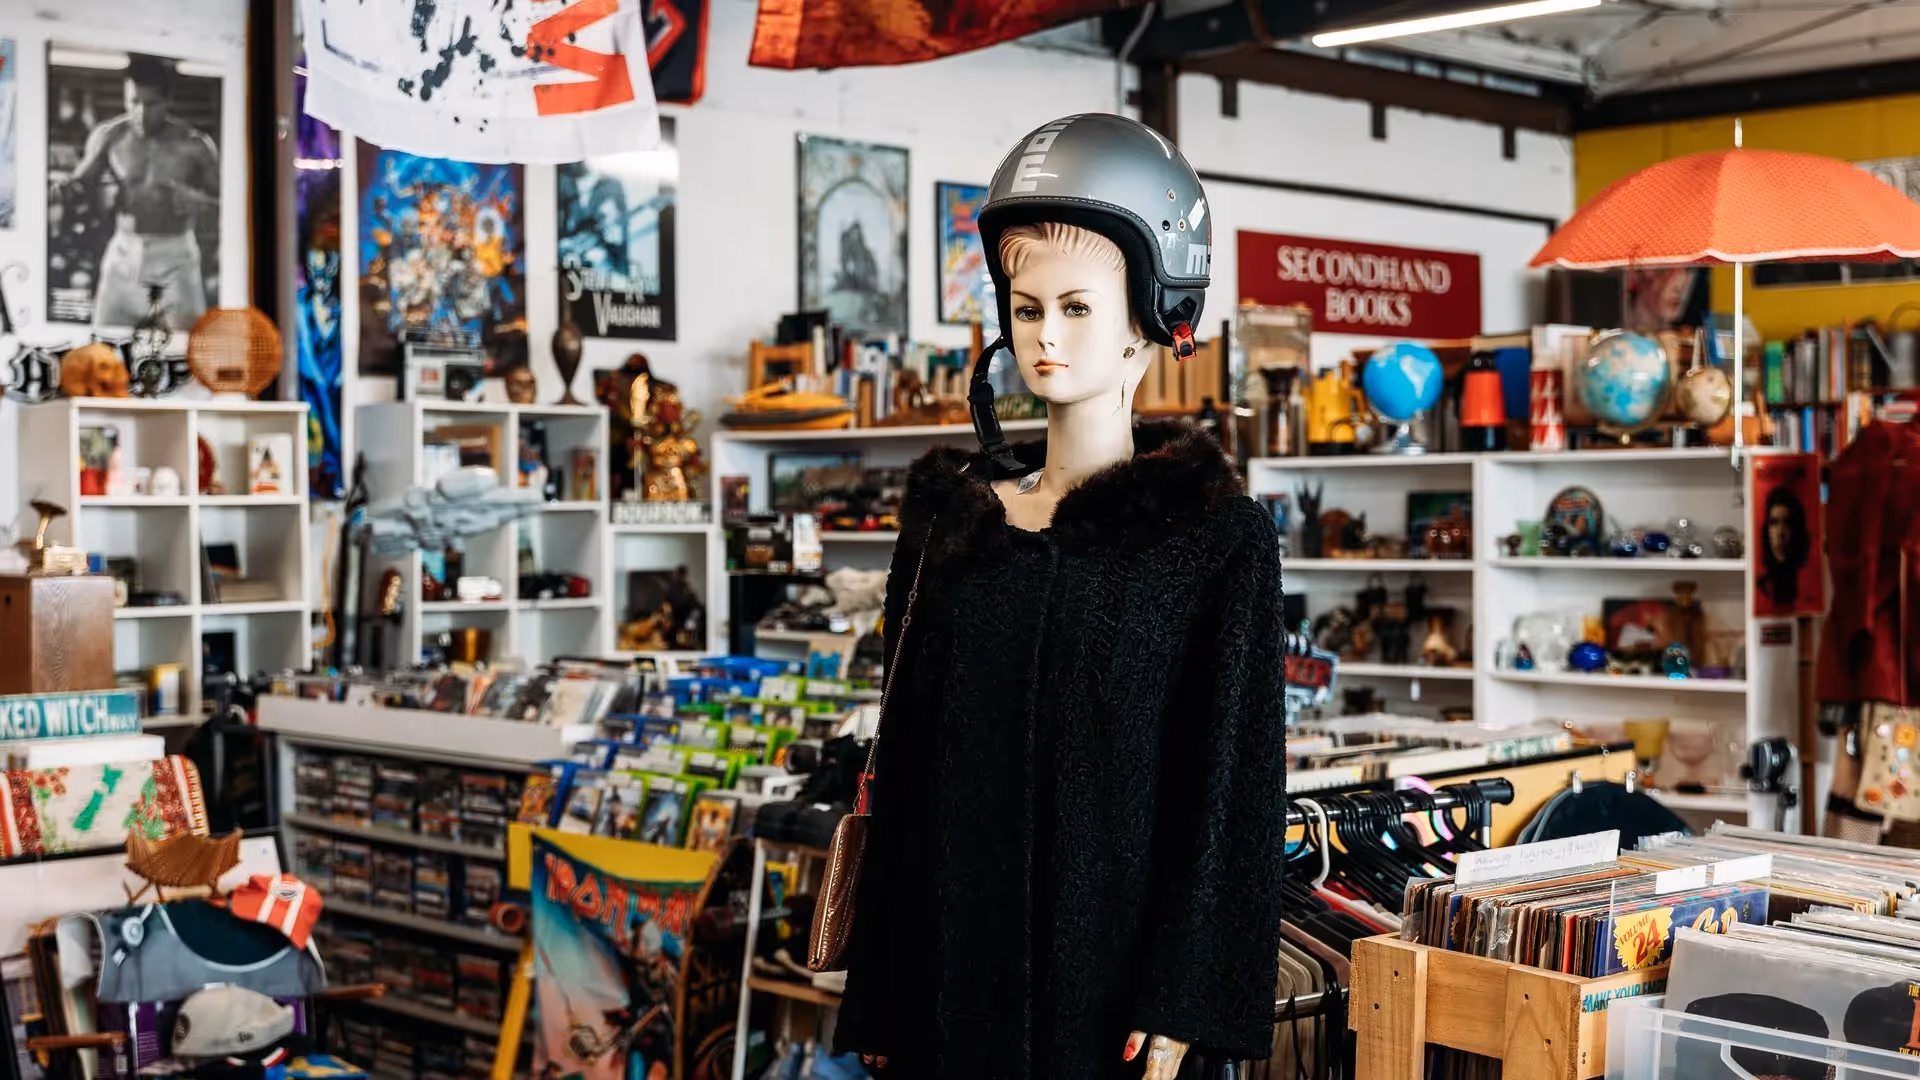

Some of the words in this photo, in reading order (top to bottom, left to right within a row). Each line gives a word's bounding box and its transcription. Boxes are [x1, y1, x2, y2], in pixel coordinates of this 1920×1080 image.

[1277, 245, 1452, 294] SECONDHAND
[1325, 287, 1412, 327] BOOKS
[44, 696, 109, 737] WITCH
[1619, 914, 1650, 945] VOLUME
[1633, 918, 1661, 965] 24
[1582, 990, 1611, 1013] MAKE
[1614, 983, 1641, 1000] YOUR
